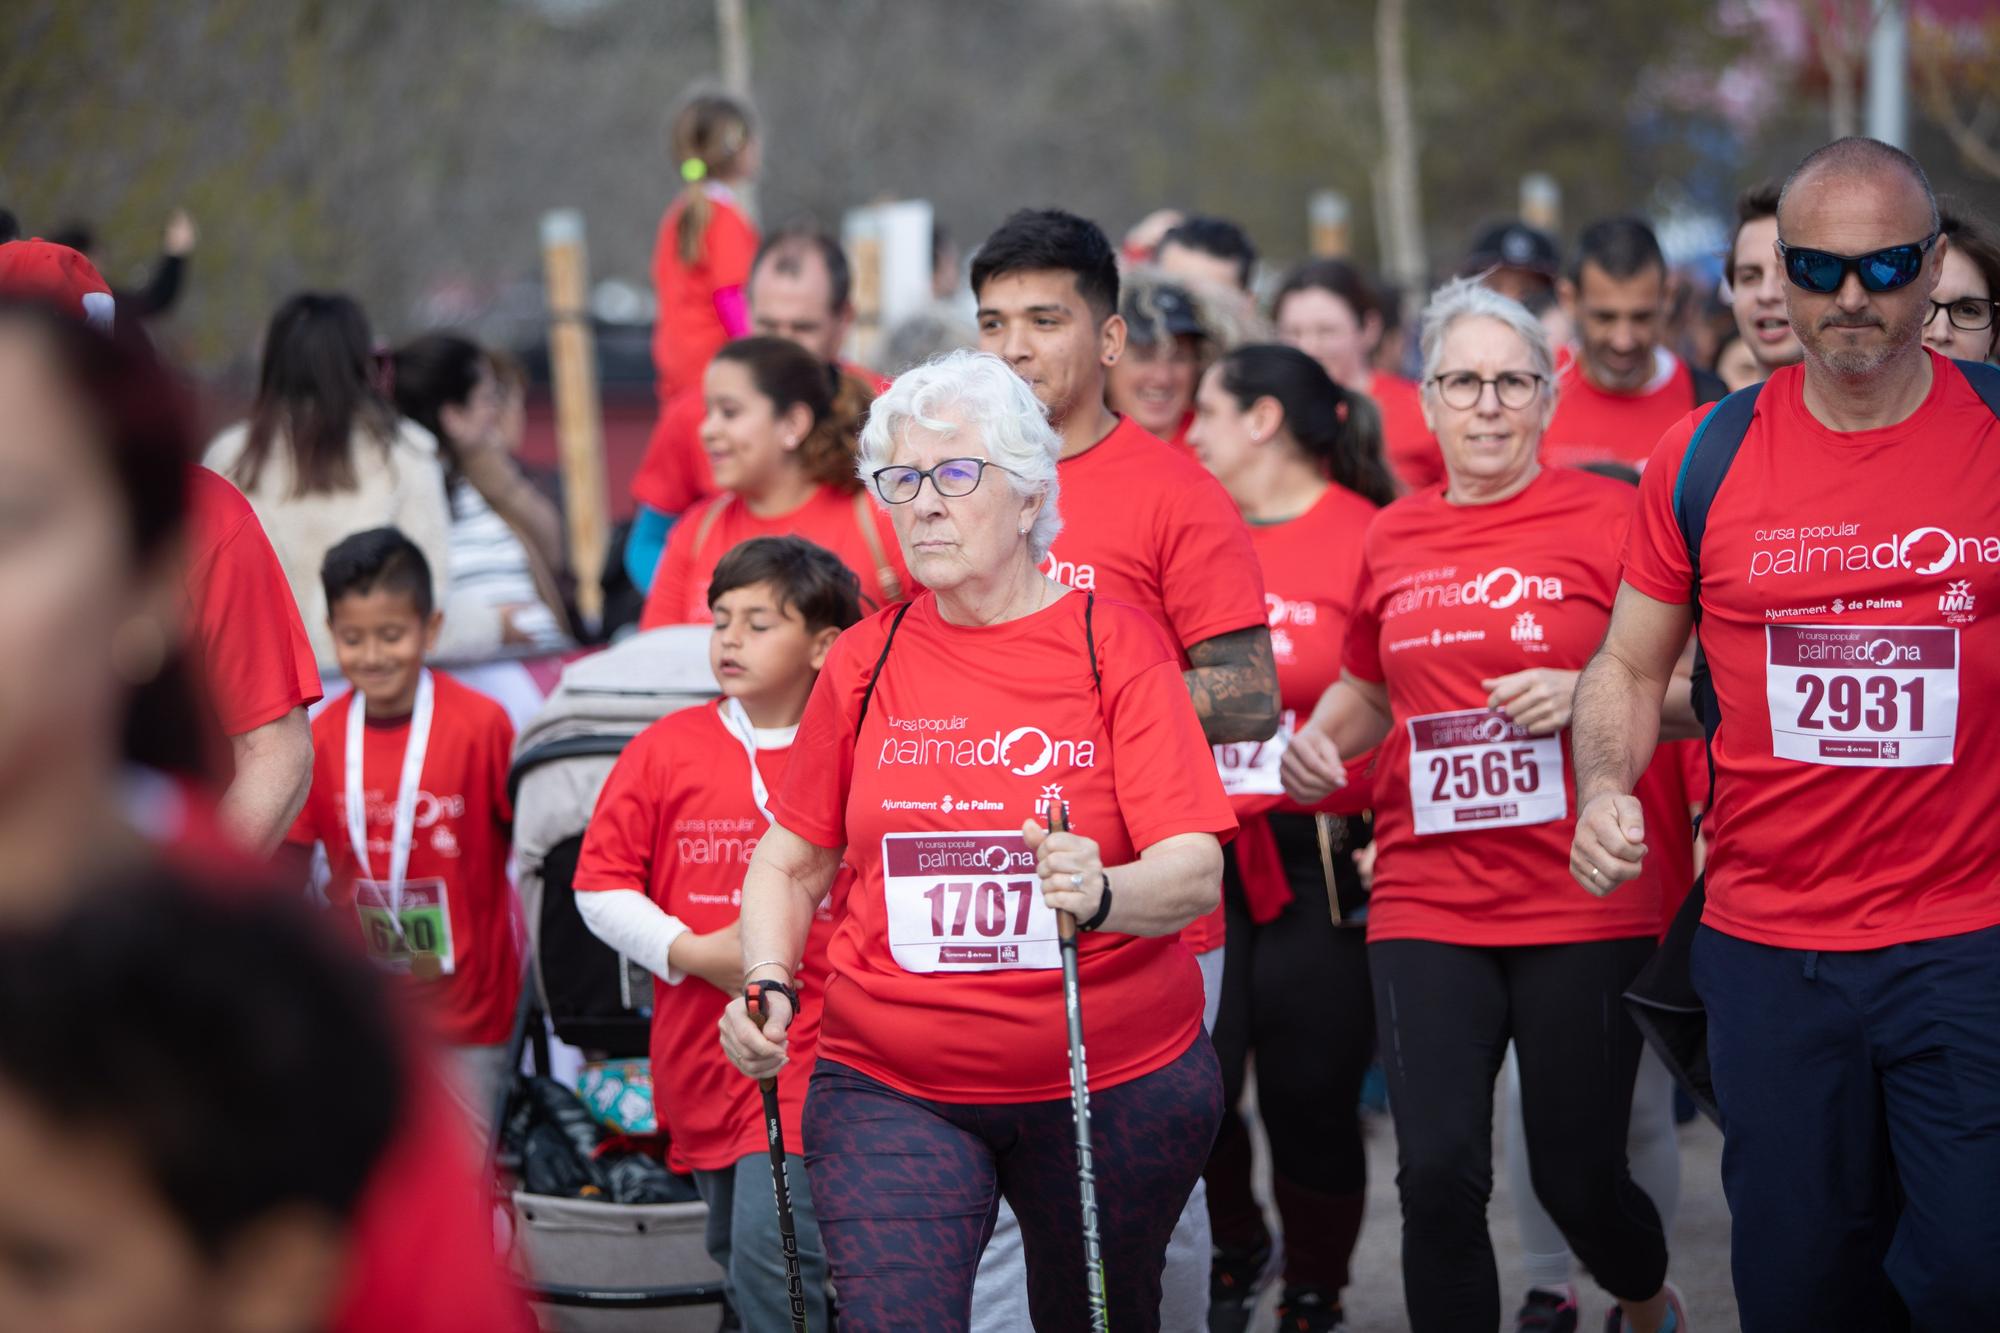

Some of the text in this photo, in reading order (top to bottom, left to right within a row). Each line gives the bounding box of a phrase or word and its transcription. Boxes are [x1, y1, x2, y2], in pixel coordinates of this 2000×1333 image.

[1755, 522, 1860, 541] cursa popular
[1765, 597, 1903, 620] Ajuntament de Palma
[1938, 595, 1976, 611] IME
[1806, 633, 1828, 641] cursa
[1830, 632, 1861, 643] popular
[1796, 673, 1924, 731] 2931
[918, 714, 969, 733] popular
[1429, 747, 1540, 802] 2565
[881, 799, 1004, 811] Ajuntament de Palma
[948, 840, 976, 850] popular
[923, 881, 1033, 937] 1707
